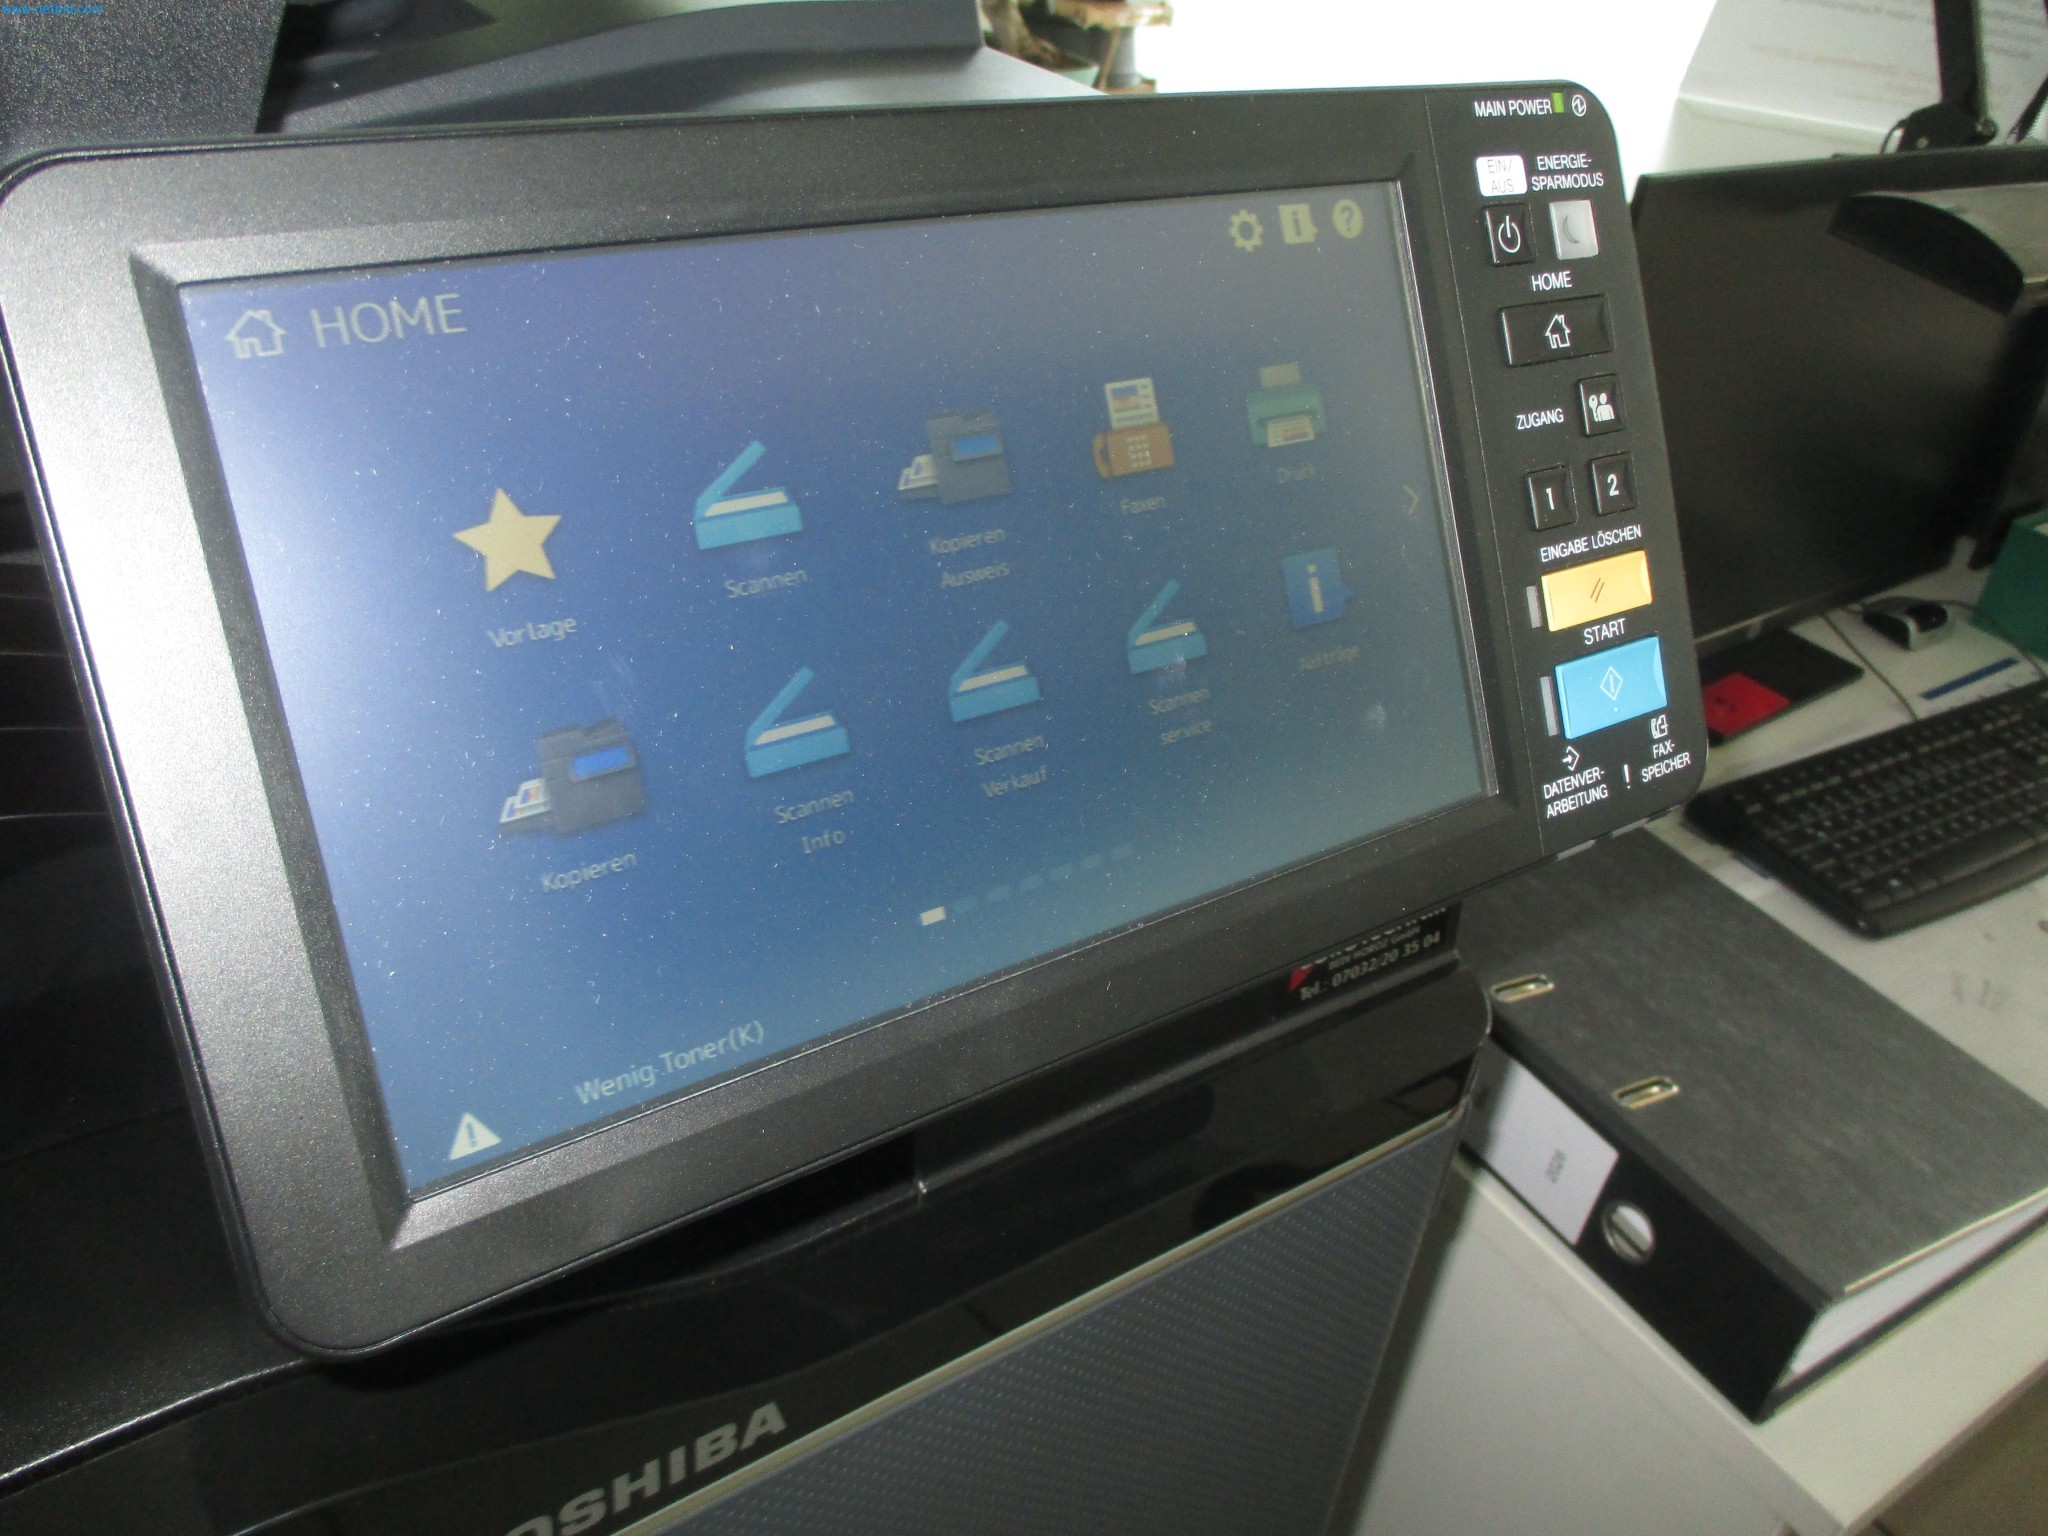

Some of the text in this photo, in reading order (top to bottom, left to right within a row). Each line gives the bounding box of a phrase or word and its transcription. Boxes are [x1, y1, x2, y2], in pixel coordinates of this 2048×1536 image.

[1474, 99, 1553, 118] MAIN POWER
[1536, 154, 1592, 171] ENERGIE-
[1491, 178, 1515, 194] AUS
[1531, 173, 1604, 192] SPARMODUS
[1531, 271, 1573, 292] HOME
[310, 293, 468, 348] HOME
[1516, 408, 1564, 430] ZUGANG
[1545, 487, 1556, 511] 1
[1607, 473, 1620, 497] 2
[929, 529, 1005, 555] Kopieren
[1540, 524, 1642, 562] EINGABE LÖSCHEN
[724, 568, 809, 599] Scannen
[486, 617, 578, 648] Vorlage
[1584, 618, 1626, 645] START
[974, 735, 1045, 766] Scannen
[1652, 739, 1675, 759] FAX-
[981, 765, 1048, 798] Verkauf
[1641, 752, 1691, 783] SPEICHER
[1543, 766, 1605, 799] DATENVER-
[773, 788, 854, 825] Scannen
[1546, 784, 1608, 819] ARBEITUNG
[801, 828, 847, 855] Info
[540, 852, 638, 894] Kopieren
[574, 1020, 765, 1104] Wenig Toner(K)
